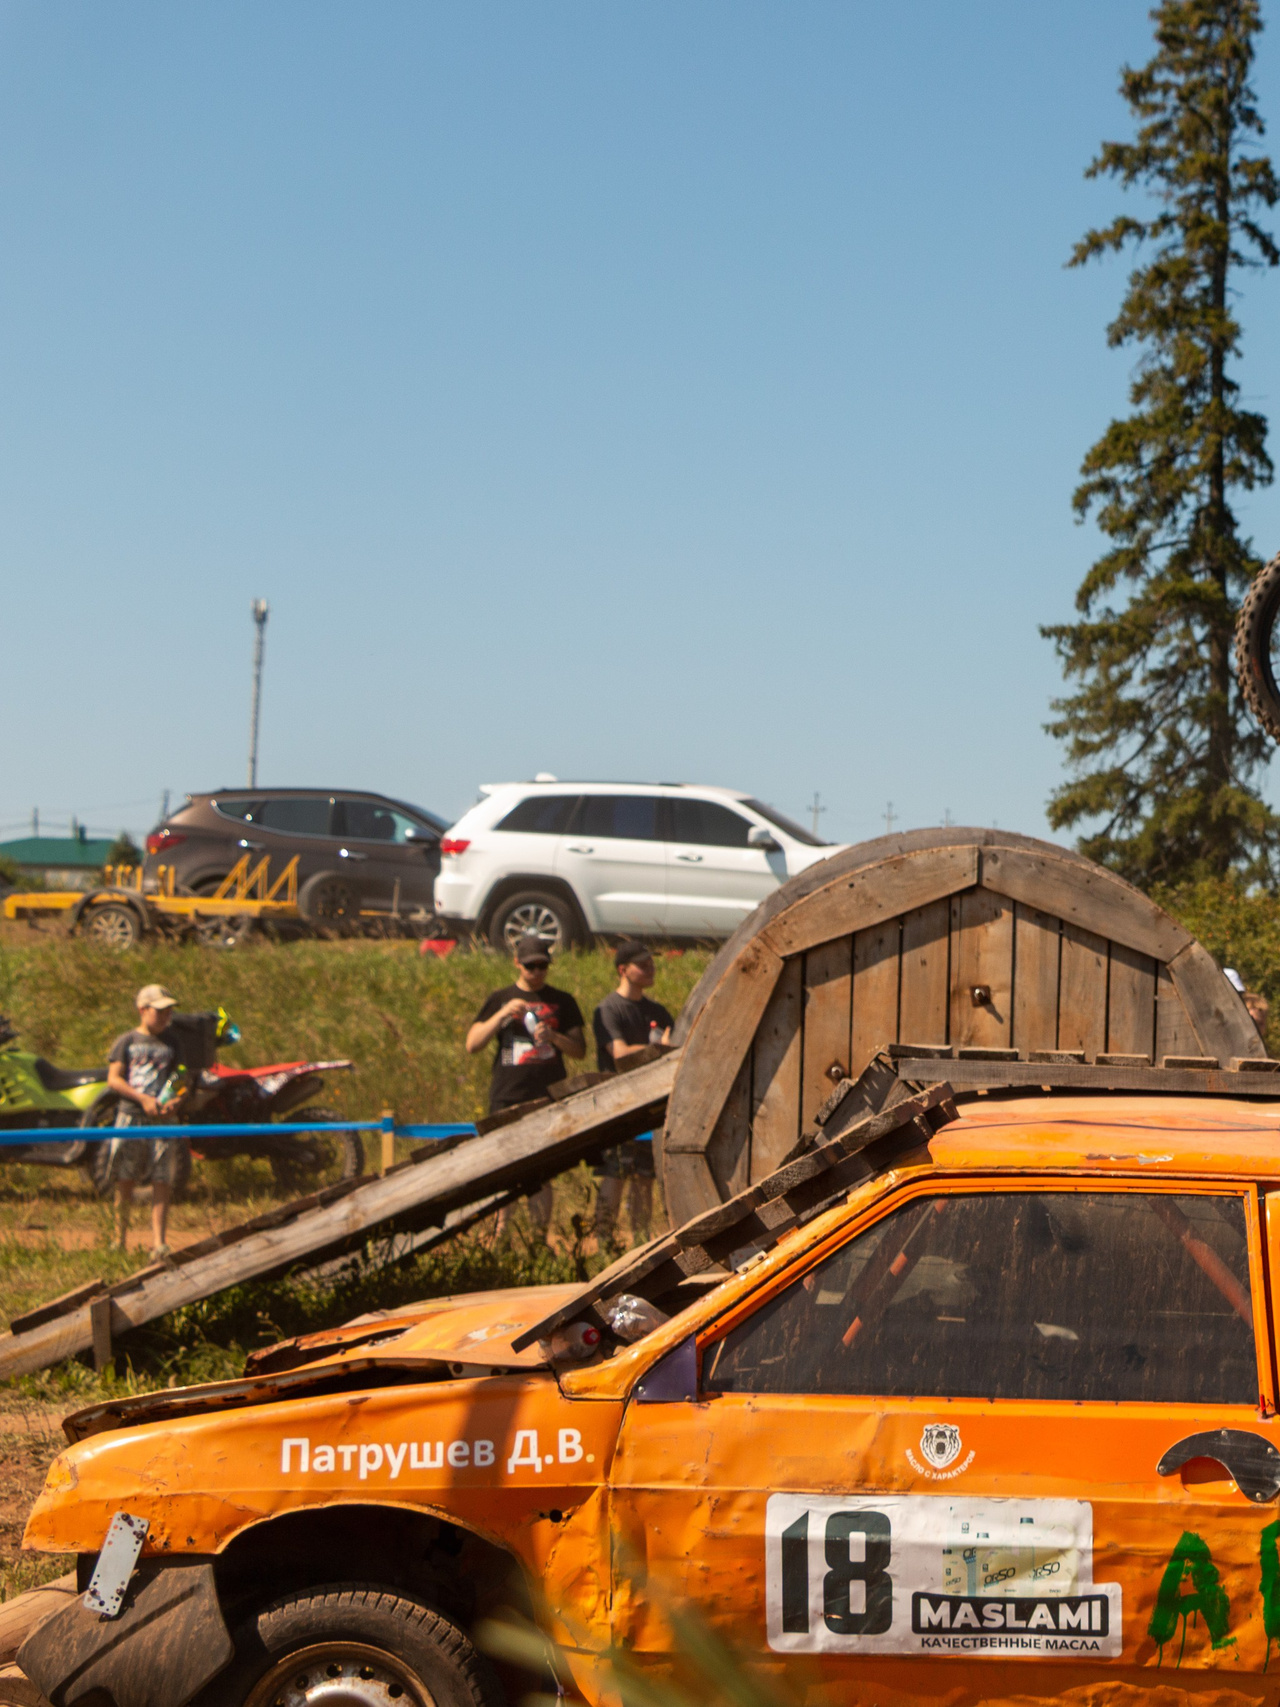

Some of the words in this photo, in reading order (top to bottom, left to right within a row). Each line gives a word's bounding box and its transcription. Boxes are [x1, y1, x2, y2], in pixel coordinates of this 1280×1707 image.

[281, 1437, 495, 1480] Патрушев
[507, 1428, 596, 1475] Д.В.
[905, 1448, 925, 1474] МАСЛО
[931, 1450, 976, 1480] ХАРАКТЕРОМ
[781, 1510, 893, 1635] 18
[984, 1567, 1016, 1585] ORSO
[919, 1597, 1101, 1631] MASLAMI
[921, 1637, 1041, 1650] КАЧЕСТВЕННЫЕ
[1045, 1638, 1101, 1651] МАСЛА
